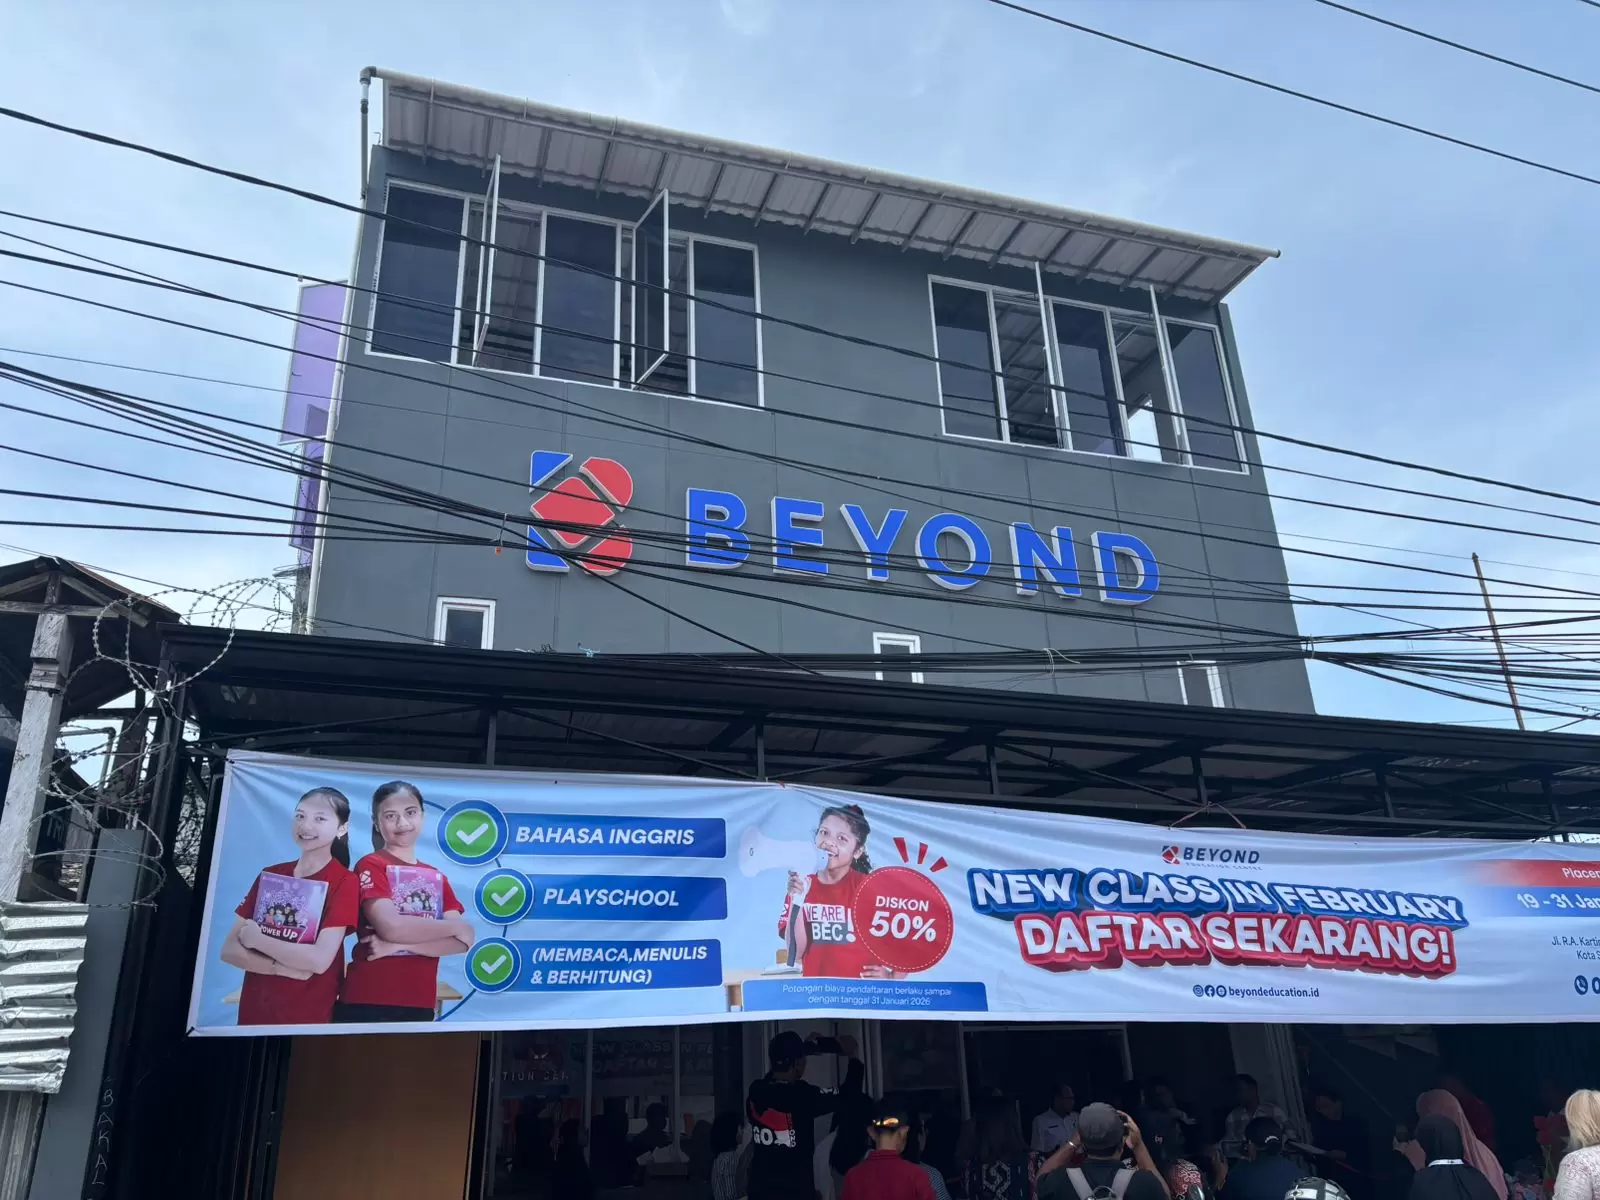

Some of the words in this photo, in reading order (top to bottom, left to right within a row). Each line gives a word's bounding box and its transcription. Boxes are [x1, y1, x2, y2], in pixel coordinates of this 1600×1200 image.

[686, 487, 1160, 606] BEYOND
[515, 826, 604, 844] BAHASA
[609, 829, 695, 845] INGGRIS
[1183, 847, 1260, 864] BEYOND
[543, 887, 680, 907] PLAYSCHOOL
[875, 895, 929, 912] DISKON
[971, 870, 1074, 906] NEW
[1087, 871, 1222, 905] CLASS
[1223, 880, 1273, 905] IN
[1273, 884, 1463, 922] FEBRUARY
[1516, 893, 1541, 909] 19
[1550, 893, 1574, 909] 31
[821, 905, 843, 921] ARE
[869, 910, 937, 942] 50%
[1020, 914, 1201, 956] DAFTAR
[1205, 915, 1451, 965] SEKARANG!
[1562, 936, 1579, 946] R.A.
[1576, 950, 1596, 960] Kota
[530, 969, 543, 984] &
[547, 968, 653, 985] BERHITUNG)
[782, 984, 823, 994] Potongan
[825, 984, 846, 994] biaya
[846, 985, 894, 995] pendaftaran
[895, 986, 923, 995] berlaku
[924, 986, 952, 996] sampai
[1228, 986, 1320, 998] beyondeducation.id
[808, 996, 839, 1005] dengan
[840, 996, 870, 1006] tanggal
[871, 996, 880, 1005] 31
[880, 996, 910, 1006] Januari
[910, 997, 931, 1006] 2026
